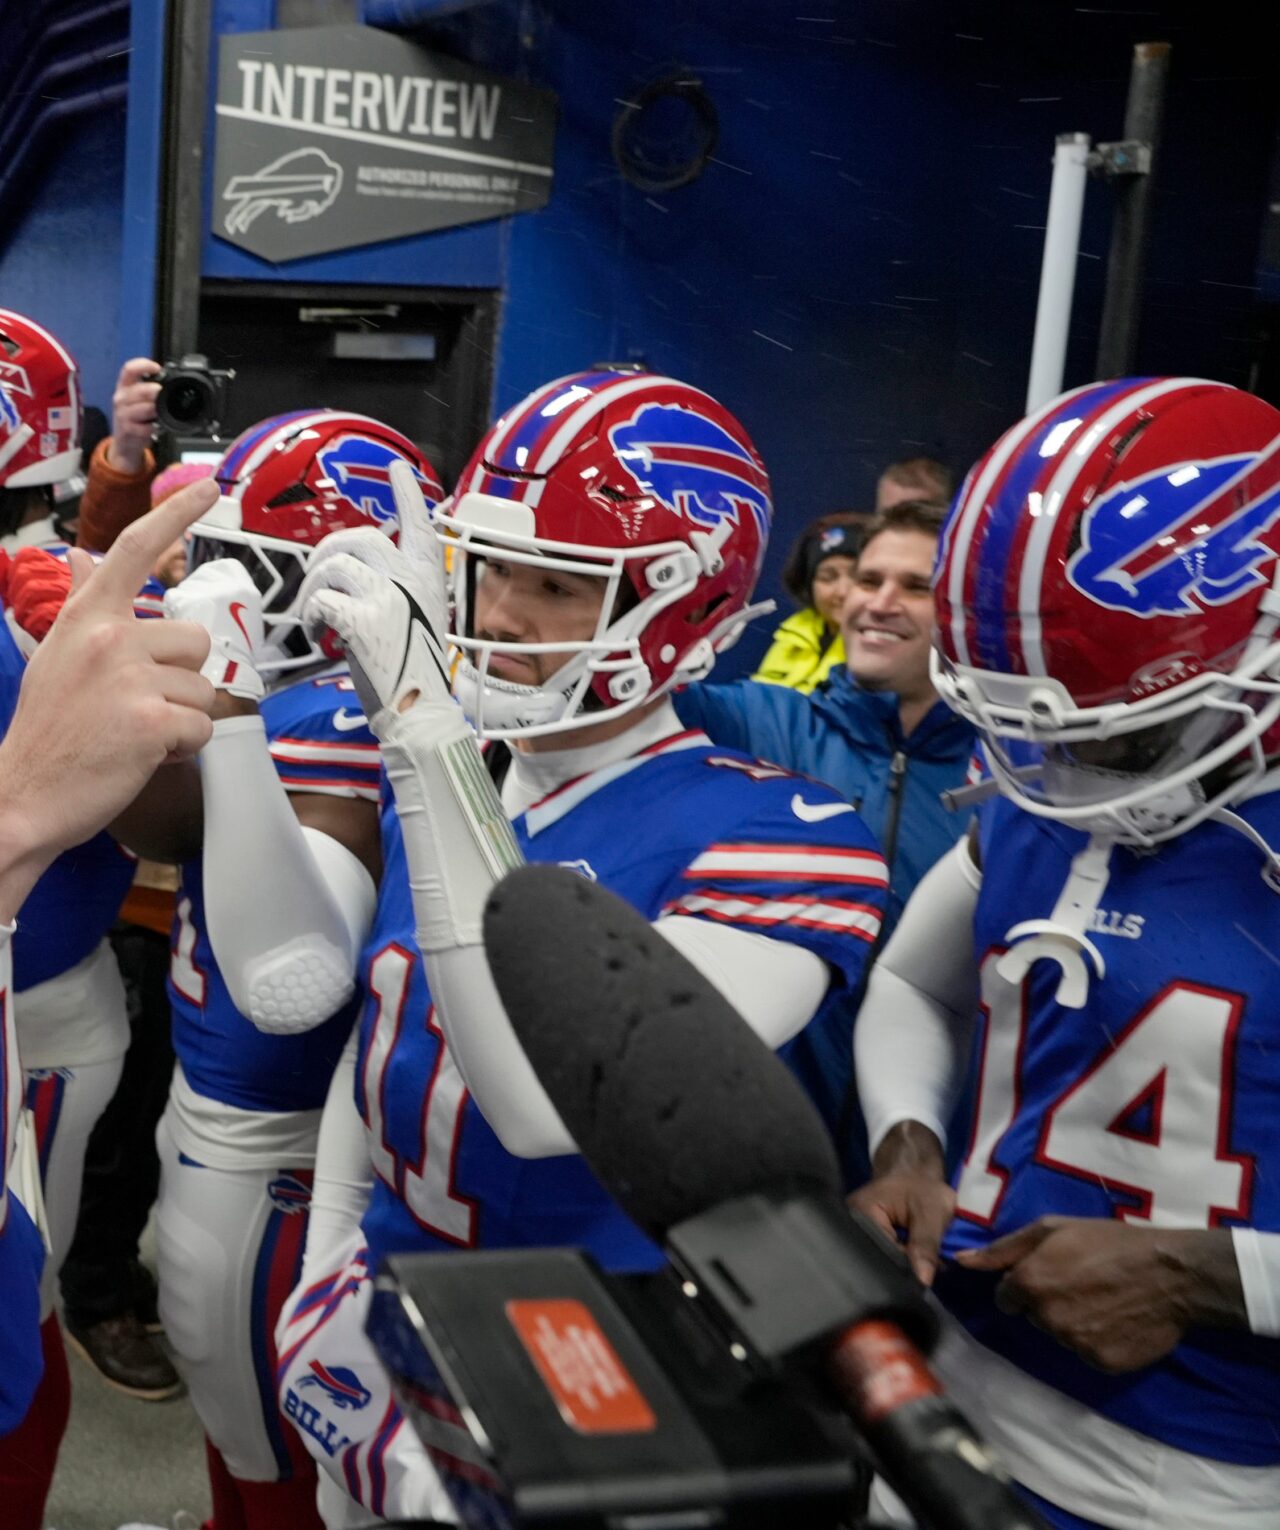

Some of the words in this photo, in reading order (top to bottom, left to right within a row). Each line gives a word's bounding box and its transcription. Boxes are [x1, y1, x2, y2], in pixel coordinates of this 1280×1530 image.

[238, 59, 501, 140] INTERVIEW
[1086, 908, 1146, 940] ILLS
[362, 940, 479, 1251] 11
[954, 944, 1258, 1232] 14
